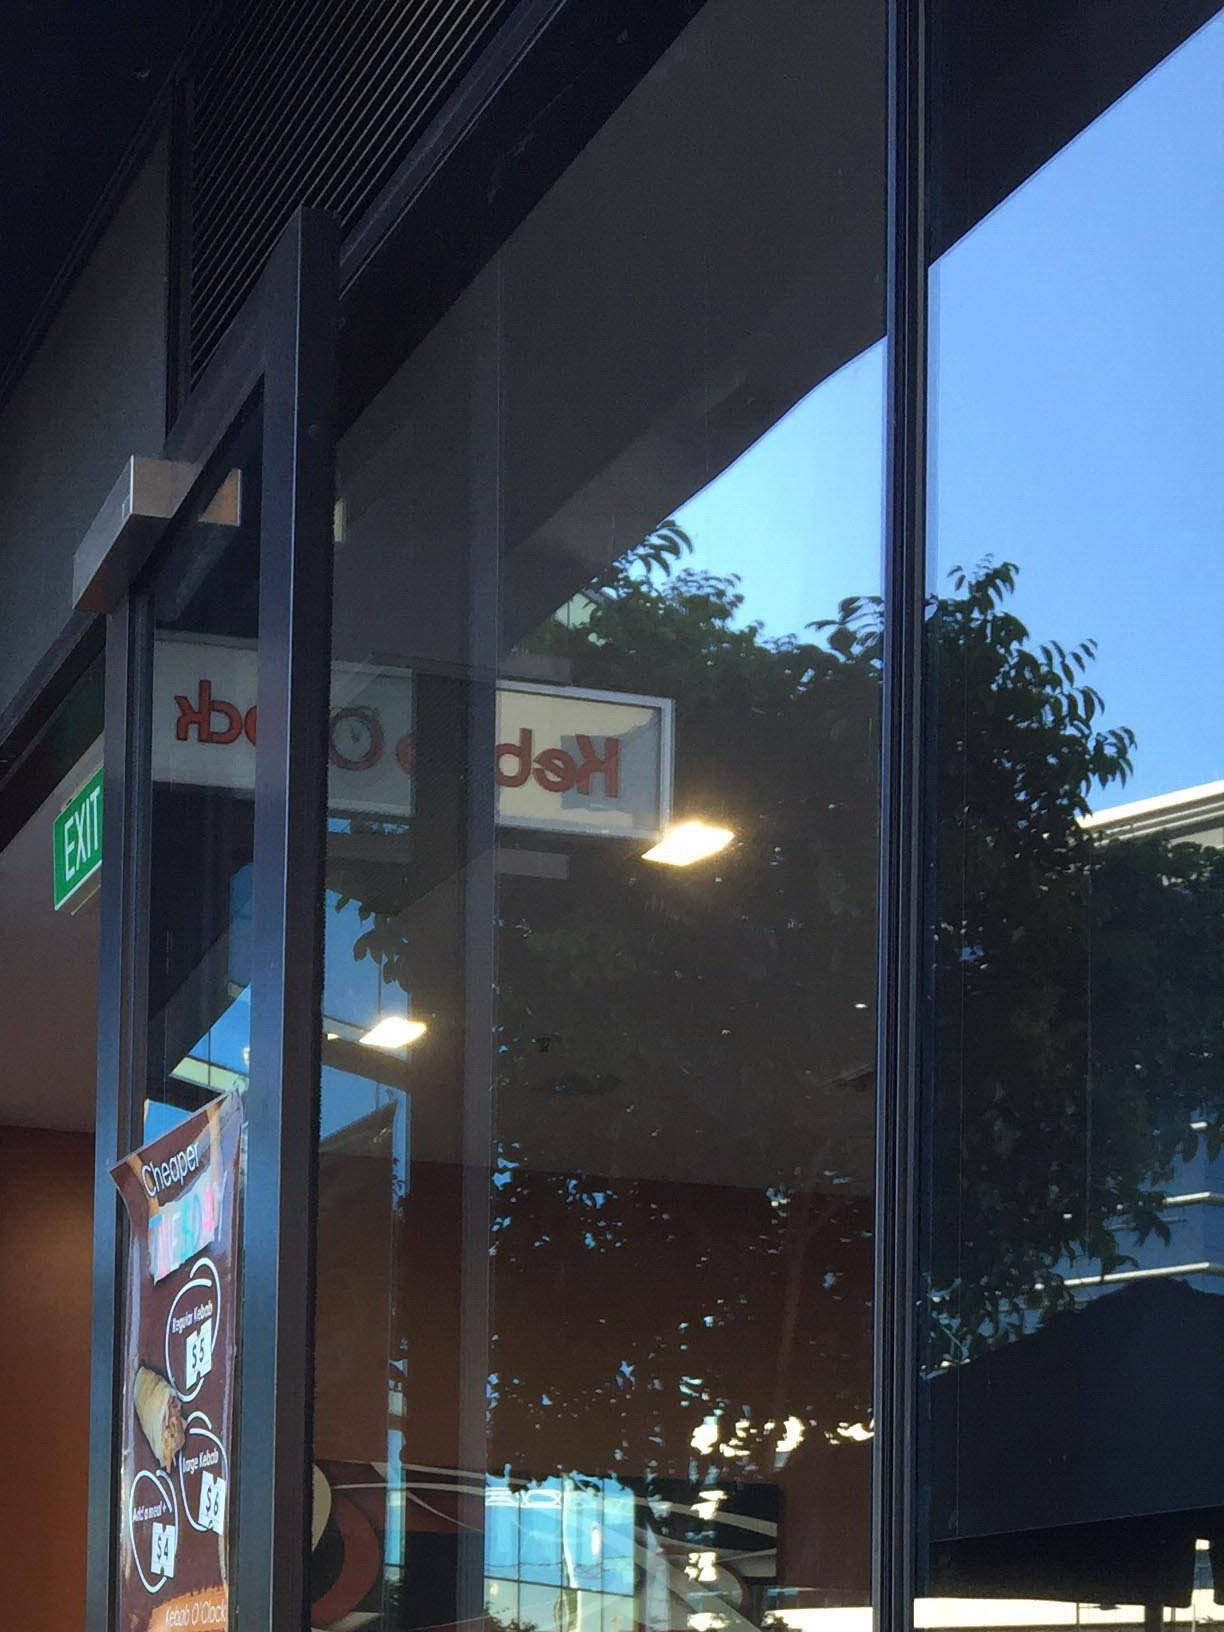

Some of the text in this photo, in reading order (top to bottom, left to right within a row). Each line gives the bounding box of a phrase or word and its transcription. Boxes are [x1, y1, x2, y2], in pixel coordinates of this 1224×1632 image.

[64, 786, 101, 881] EXIT
[141, 1142, 200, 1197] Cheaper
[199, 1448, 219, 1468] Kebab
[165, 1605, 190, 1628] Kebab
